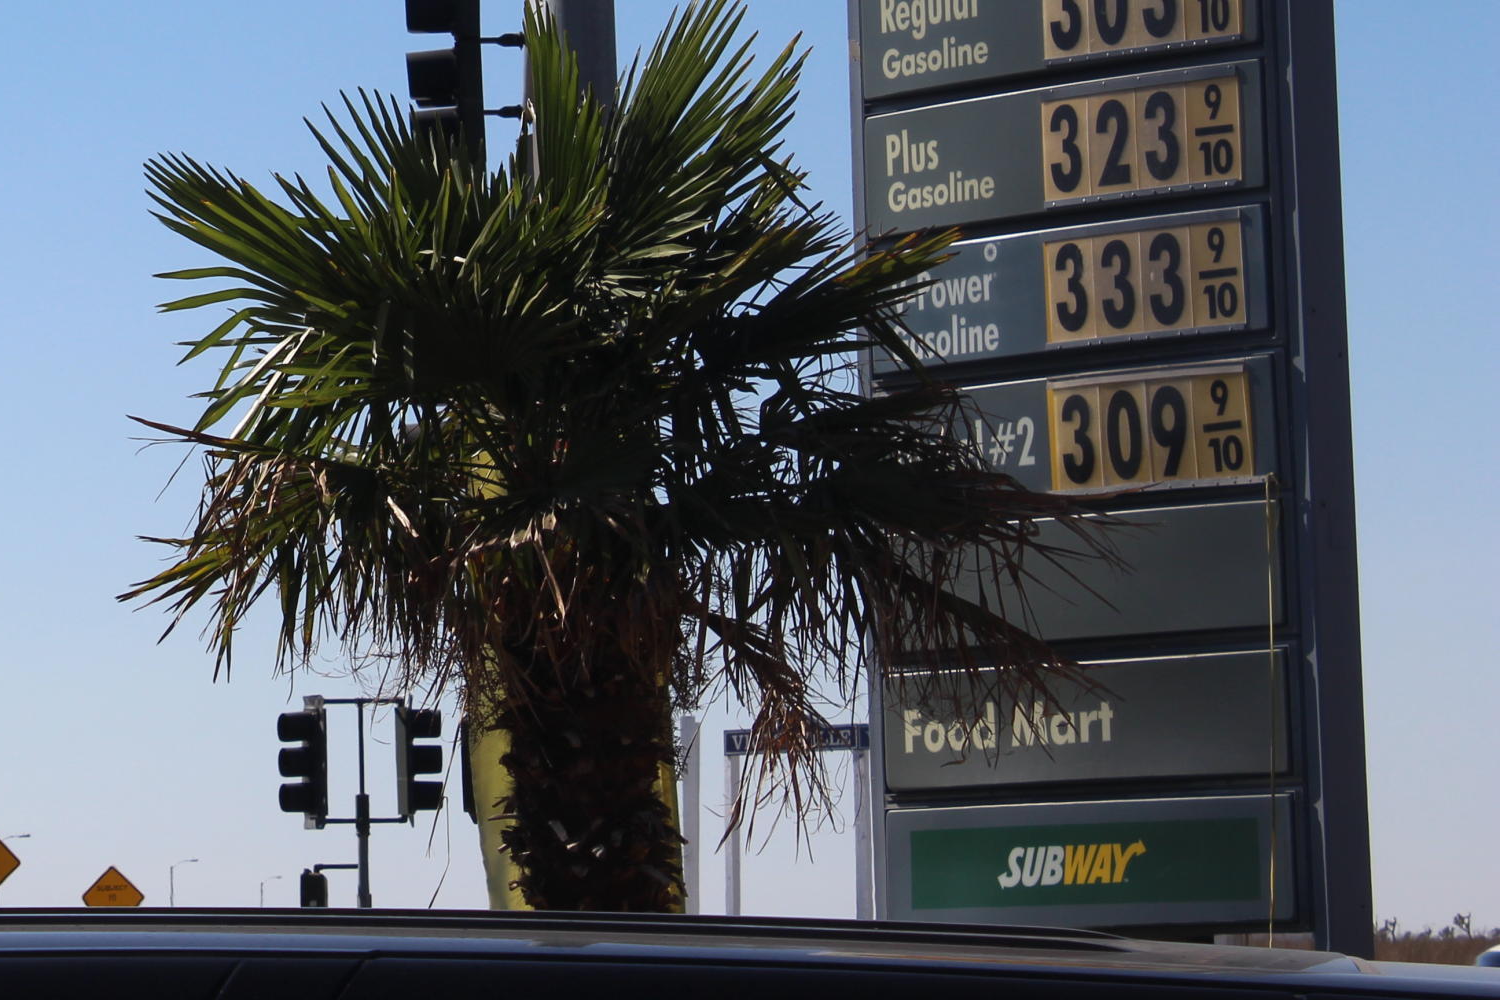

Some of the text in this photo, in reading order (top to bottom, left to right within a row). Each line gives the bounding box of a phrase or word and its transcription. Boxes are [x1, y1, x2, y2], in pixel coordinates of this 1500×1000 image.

[882, 37, 988, 80] Gasoline
[886, 130, 939, 177] Plus
[1050, 91, 1180, 193] 323
[888, 172, 995, 213] Gasoline
[1055, 233, 1185, 332] 333
[989, 416, 1036, 466] #2
[1061, 385, 1188, 485] 309
[904, 699, 1114, 754] Food Mart
[998, 840, 1146, 889] SUBWAY
